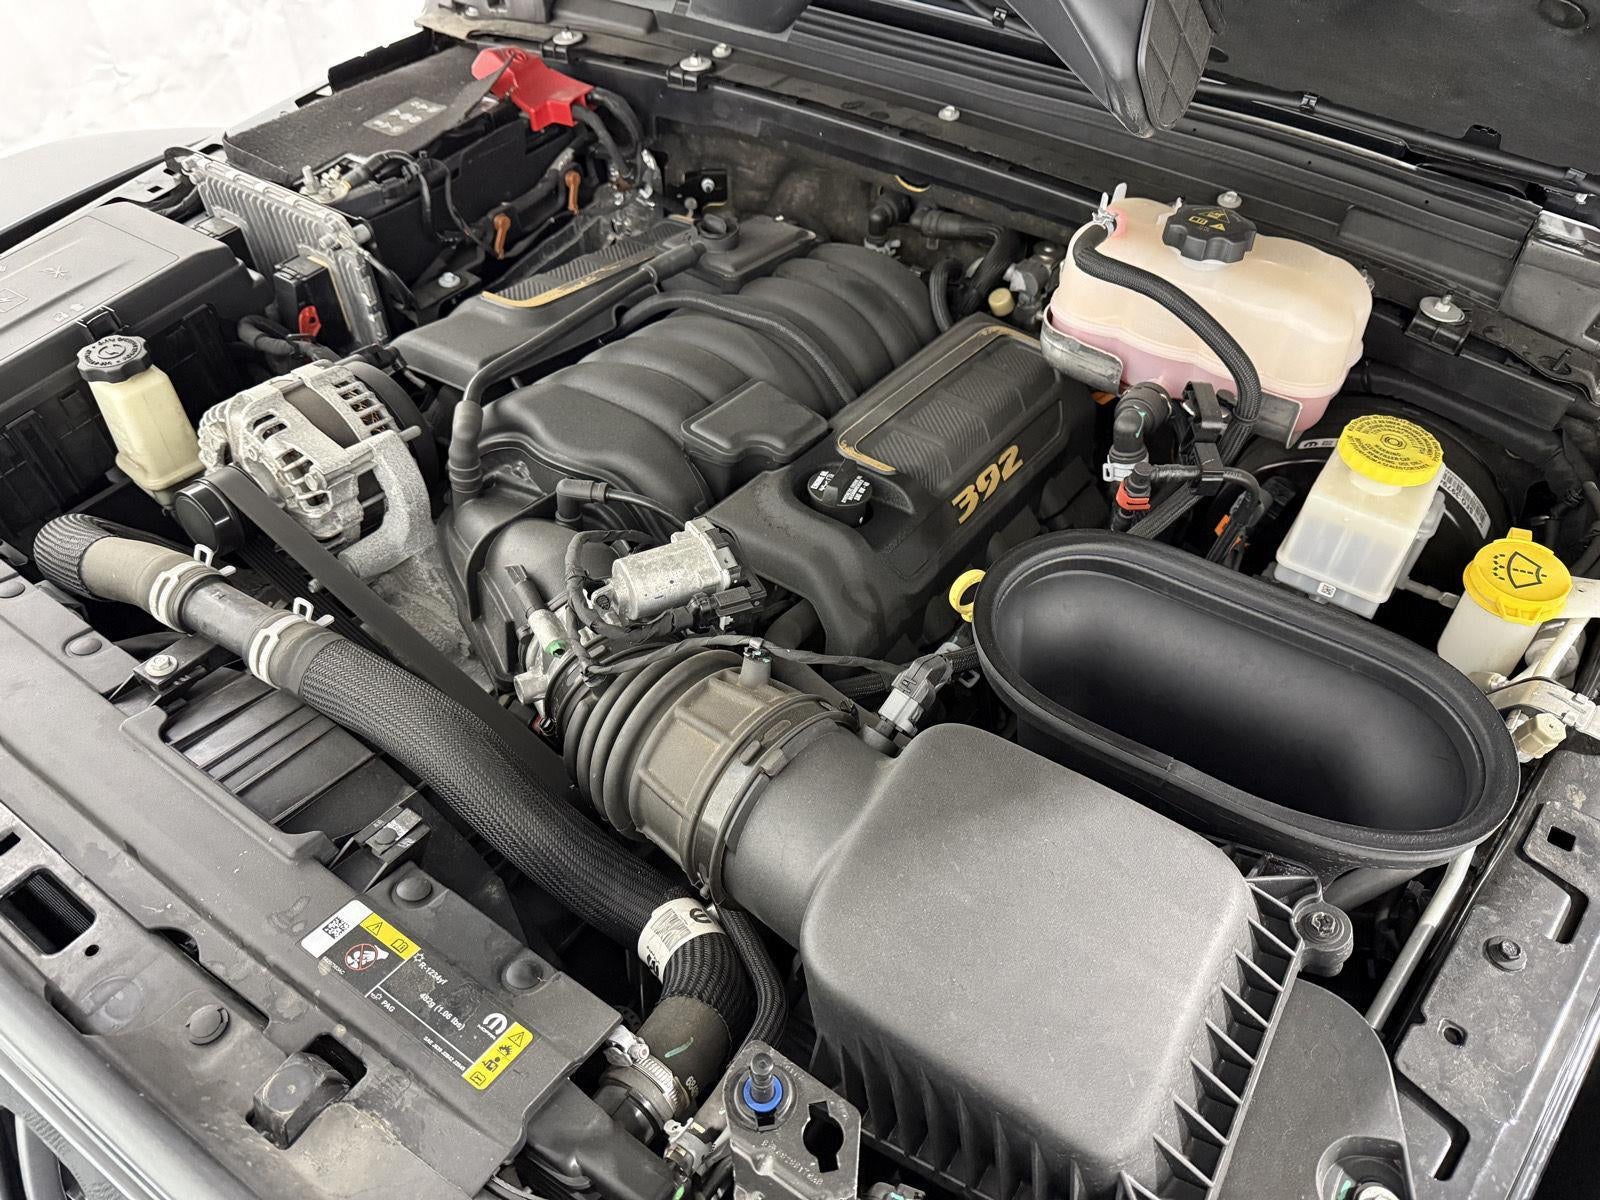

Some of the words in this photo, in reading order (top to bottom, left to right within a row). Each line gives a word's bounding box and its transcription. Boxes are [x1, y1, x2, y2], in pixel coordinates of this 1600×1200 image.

[951, 444, 1024, 525] 392
[418, 961, 449, 985] R-1234yf
[381, 1000, 396, 1013] PAG
